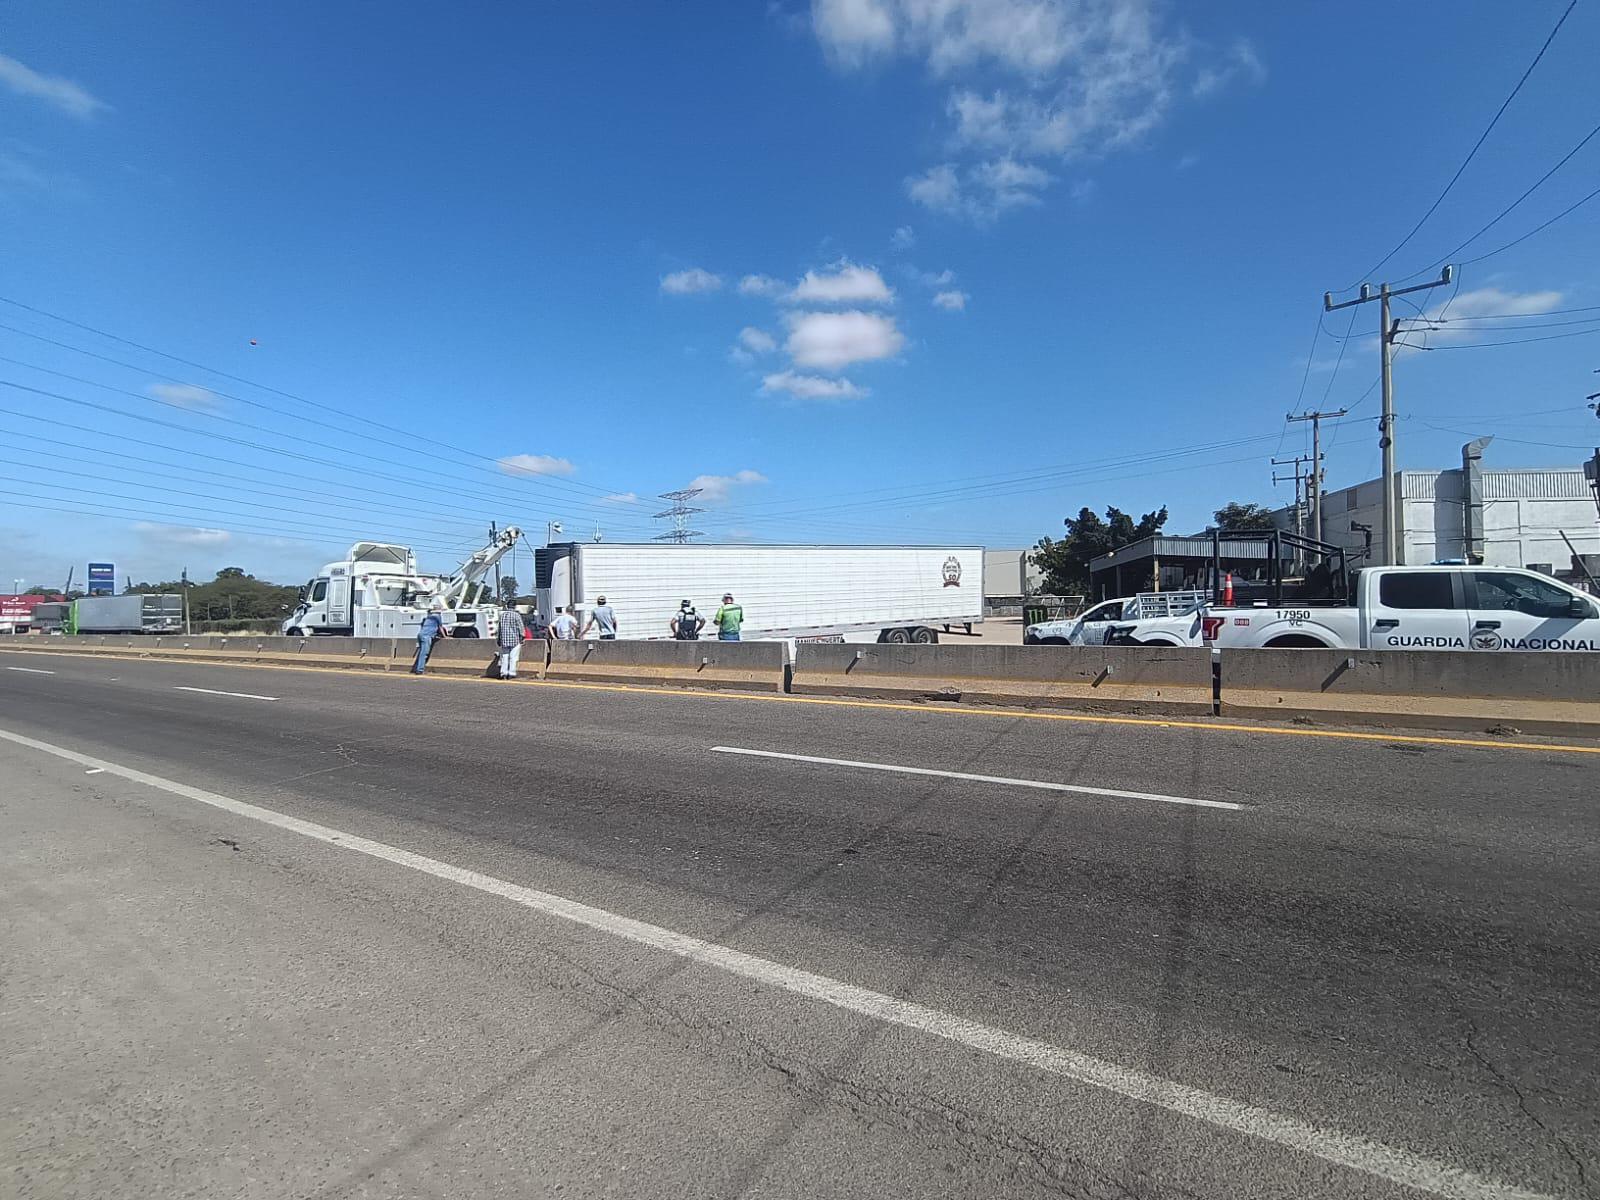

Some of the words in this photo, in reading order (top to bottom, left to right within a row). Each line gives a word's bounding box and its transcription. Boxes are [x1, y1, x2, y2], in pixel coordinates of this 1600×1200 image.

[1275, 610, 1311, 619] 17950
[1387, 636, 1465, 648] GUARDIA
[1503, 638, 1600, 651] NACIONAL
